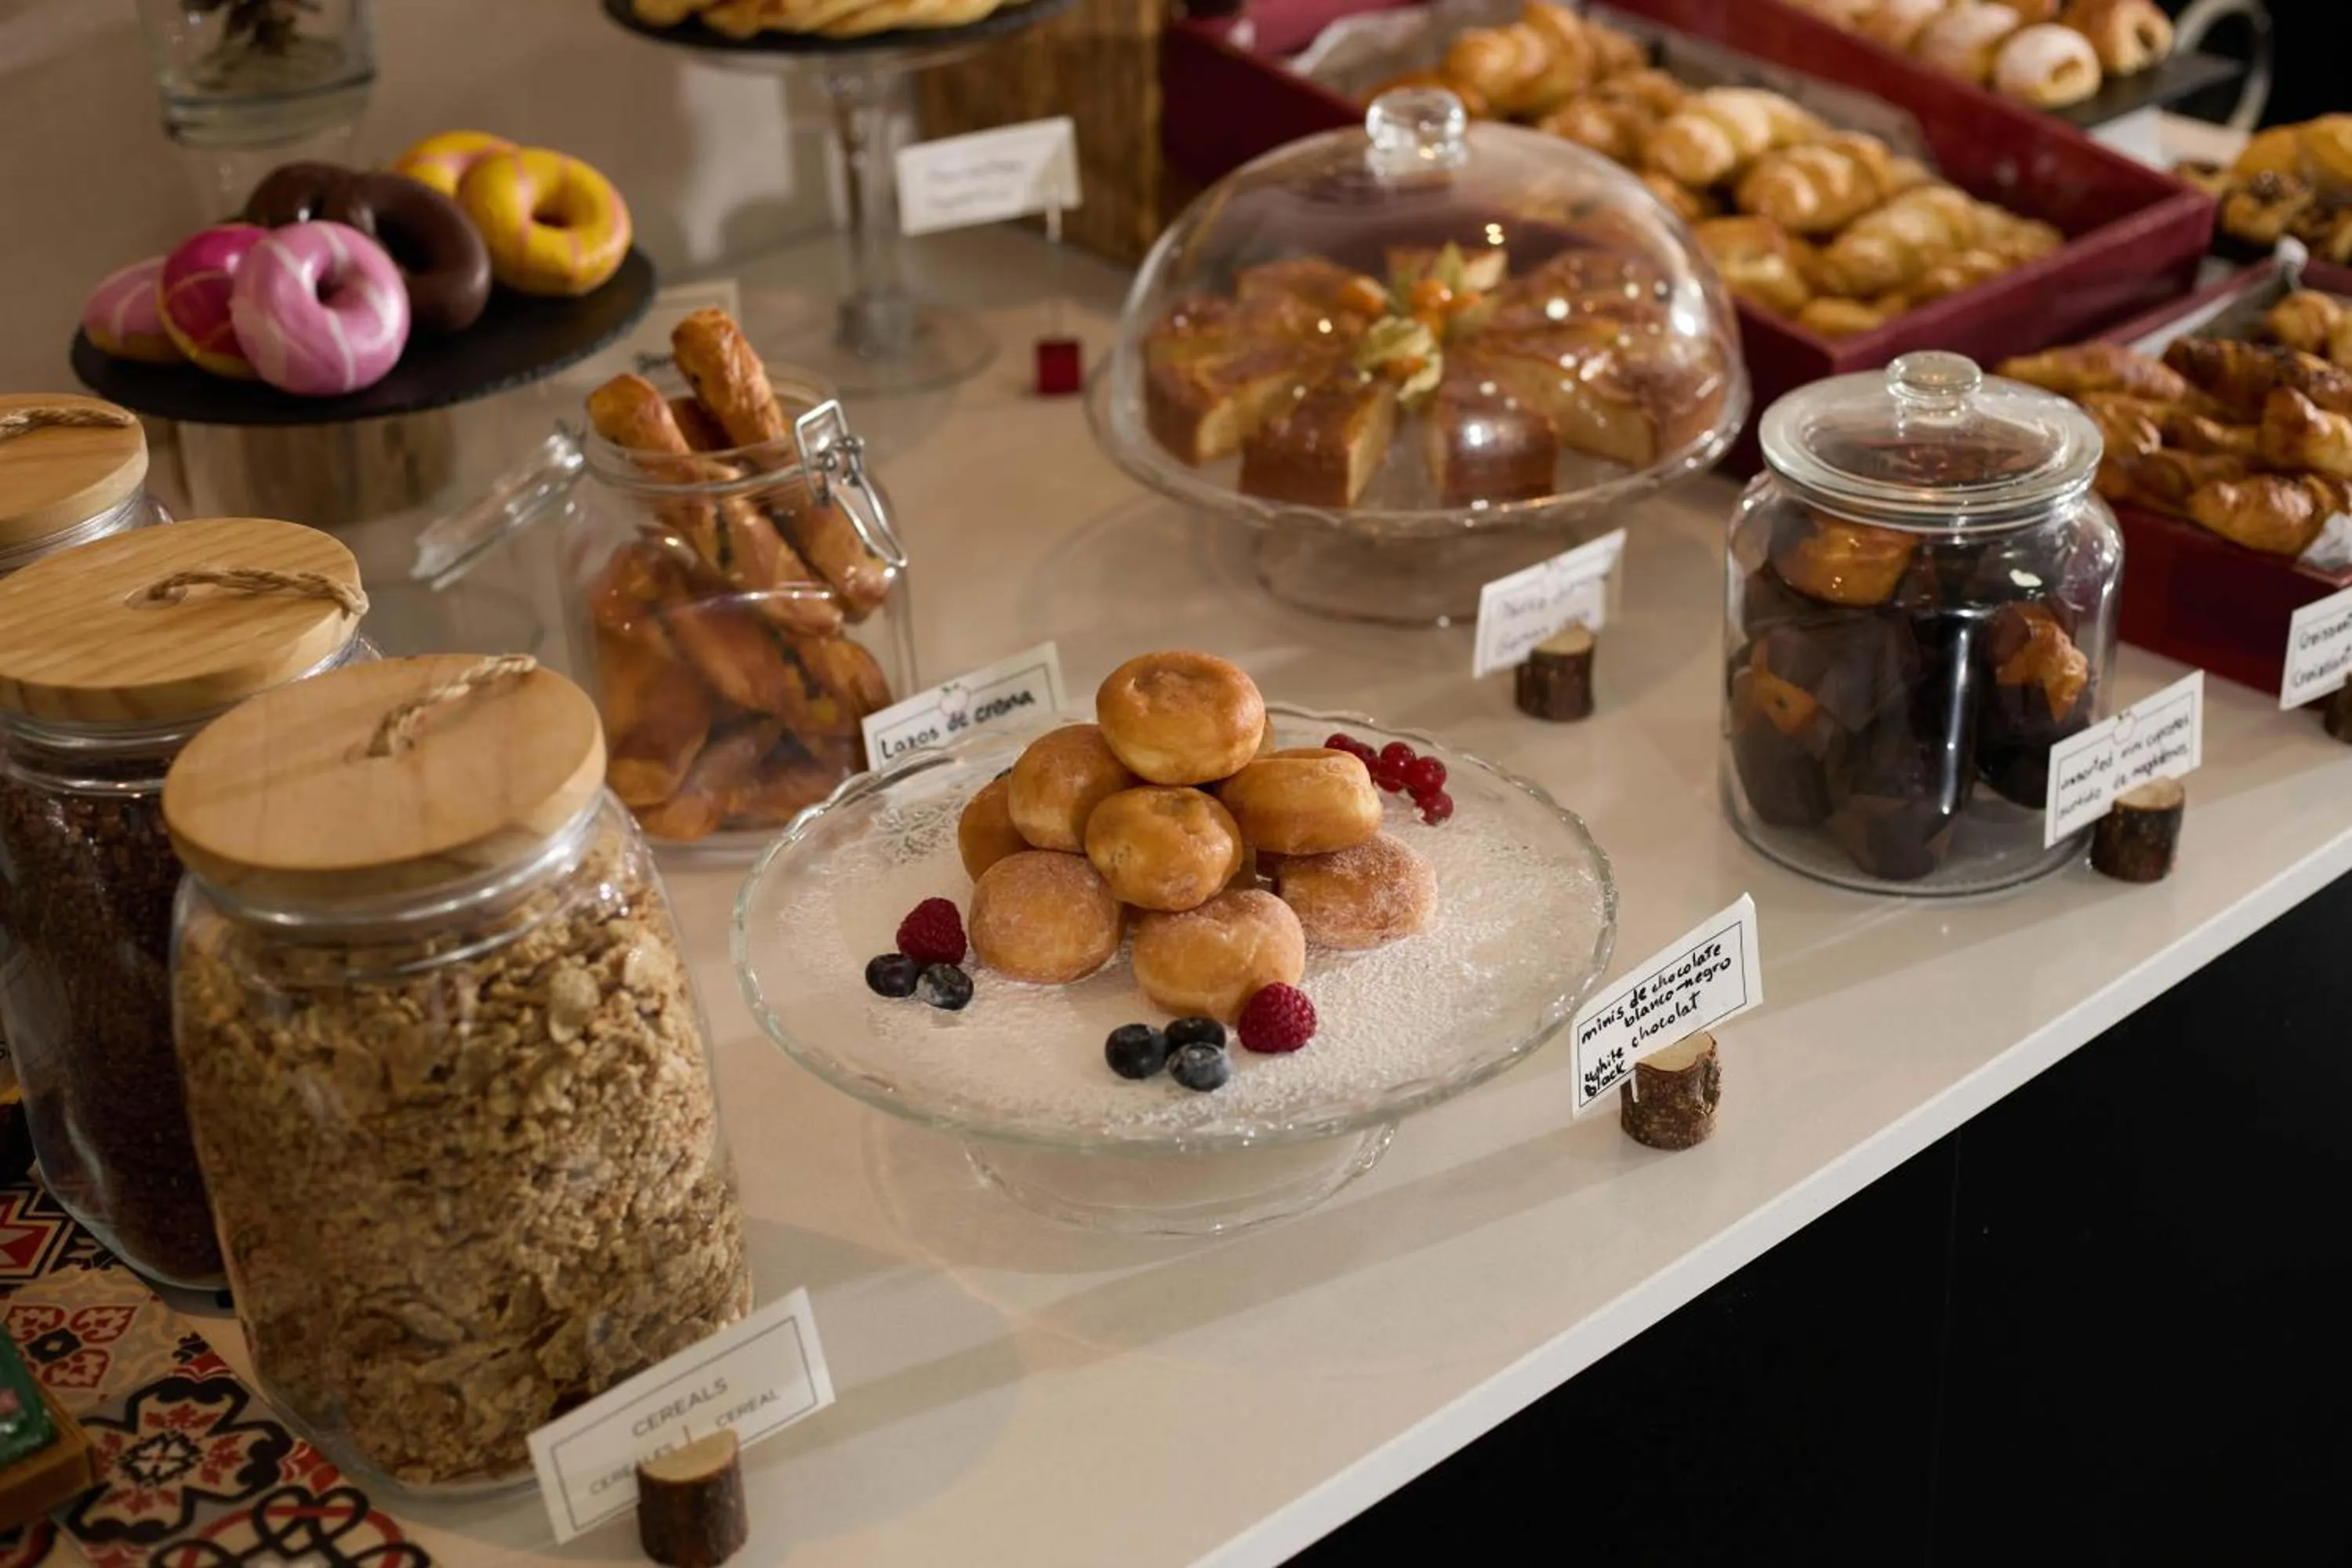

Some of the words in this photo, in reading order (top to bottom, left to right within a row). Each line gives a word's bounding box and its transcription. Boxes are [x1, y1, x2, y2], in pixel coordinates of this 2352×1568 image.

[947, 710, 969, 732] de
[974, 690, 1036, 723] crema
[1581, 1006, 1624, 1044] minis
[1629, 987, 1647, 1009] de
[1584, 1046, 1624, 1082] white
[1632, 990, 1700, 1048] chocolat
[631, 1377, 728, 1438] CEREALS
[714, 1388, 782, 1429] CEREAL
